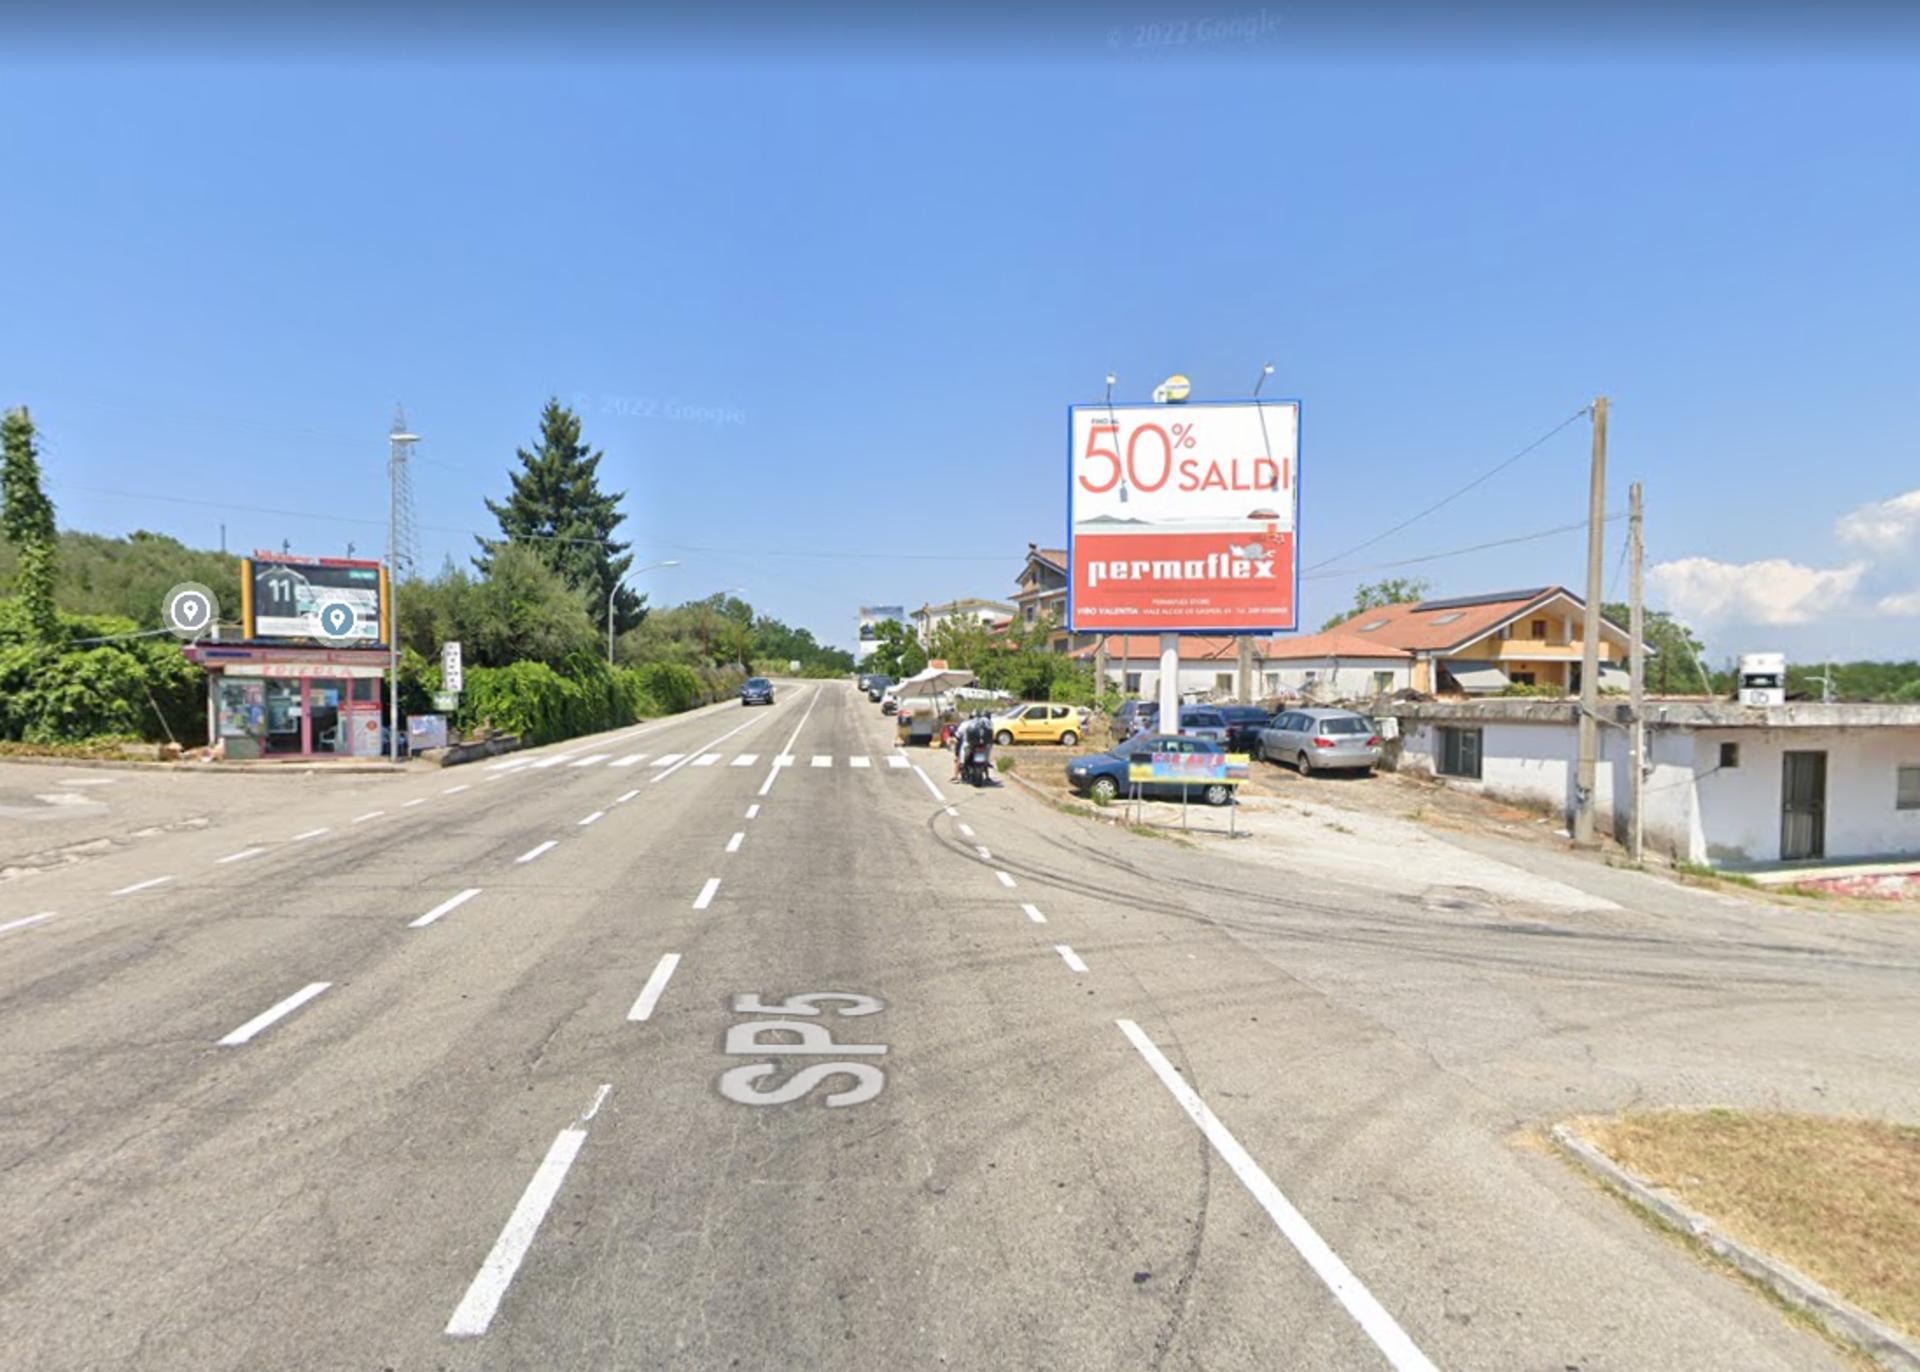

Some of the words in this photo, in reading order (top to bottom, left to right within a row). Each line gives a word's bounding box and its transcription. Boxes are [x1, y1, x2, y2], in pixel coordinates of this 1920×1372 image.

[1178, 457, 1290, 493] SALDI
[1087, 552, 1277, 588] permaflex
[268, 578, 291, 603] 11
